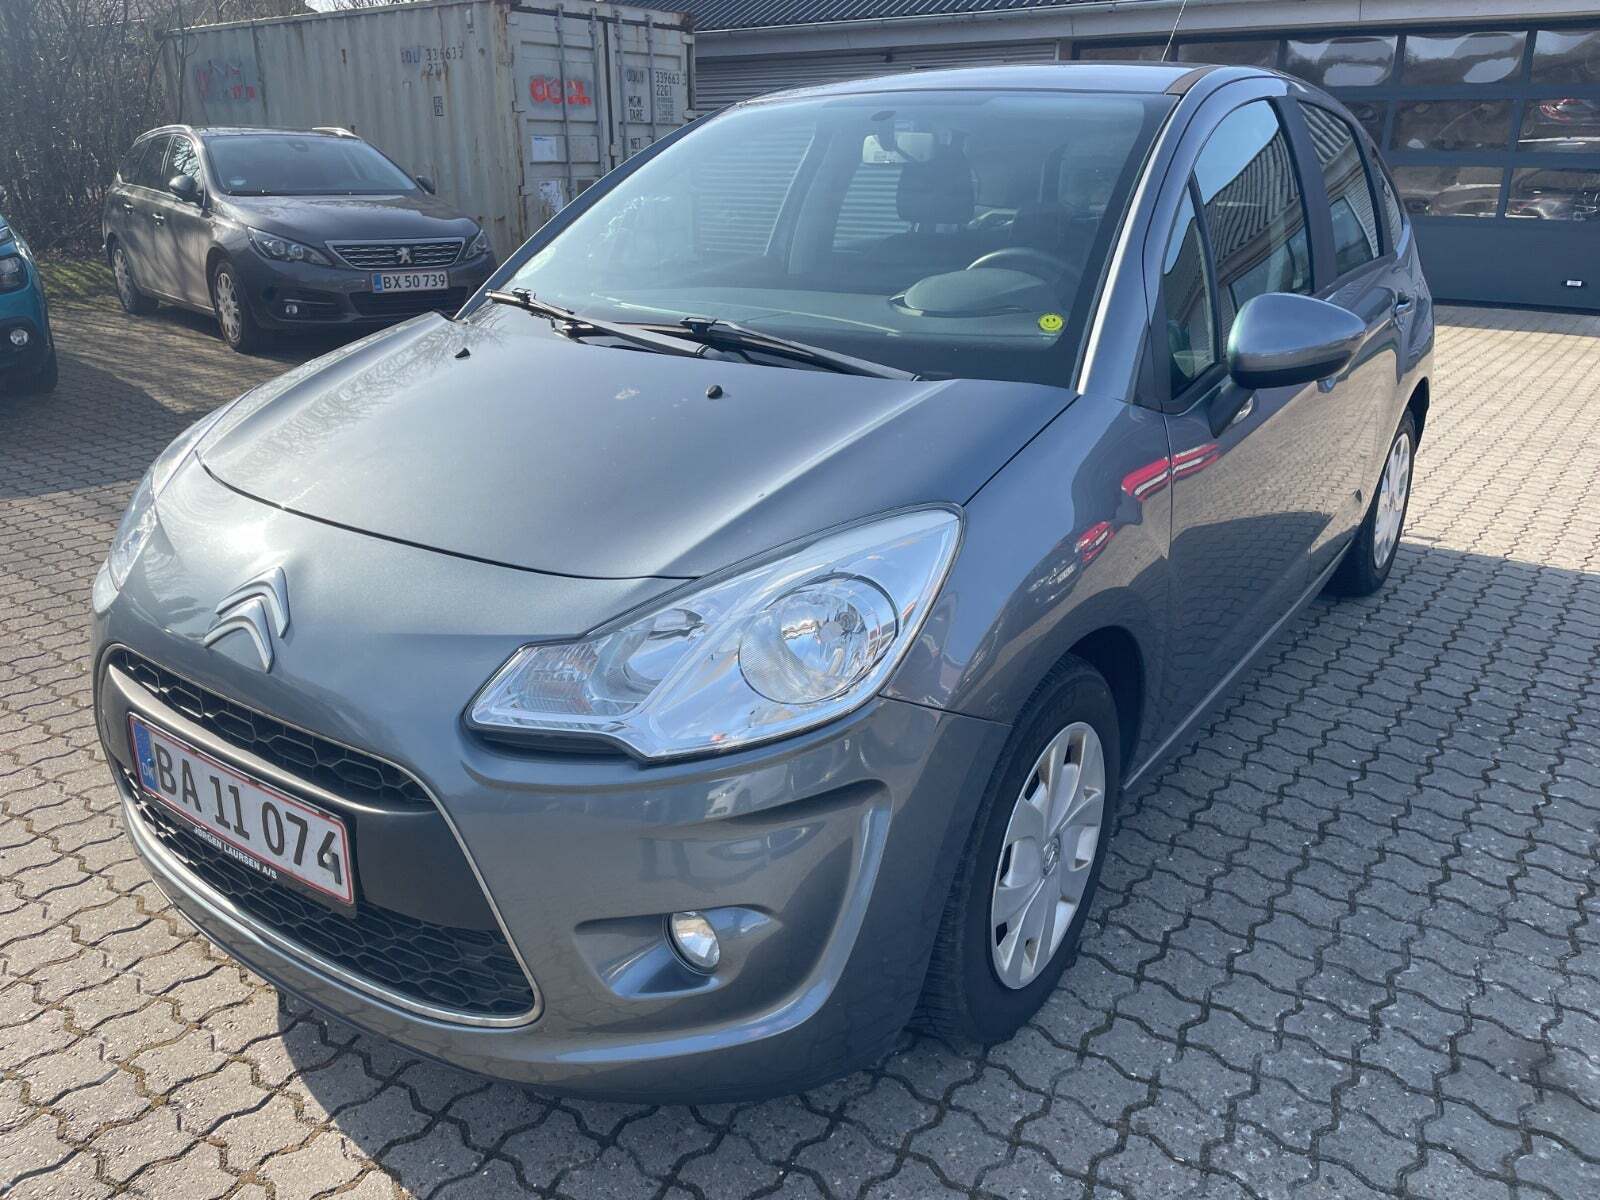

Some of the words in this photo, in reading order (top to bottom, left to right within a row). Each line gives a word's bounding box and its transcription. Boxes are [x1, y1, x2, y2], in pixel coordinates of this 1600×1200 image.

[383, 275, 402, 289] BX
[404, 274, 420, 288] 50
[423, 273, 446, 287] 739
[154, 742, 202, 813] BA
[209, 775, 250, 841] 11
[262, 800, 342, 886] 074
[223, 843, 260, 870] LAURSEN
